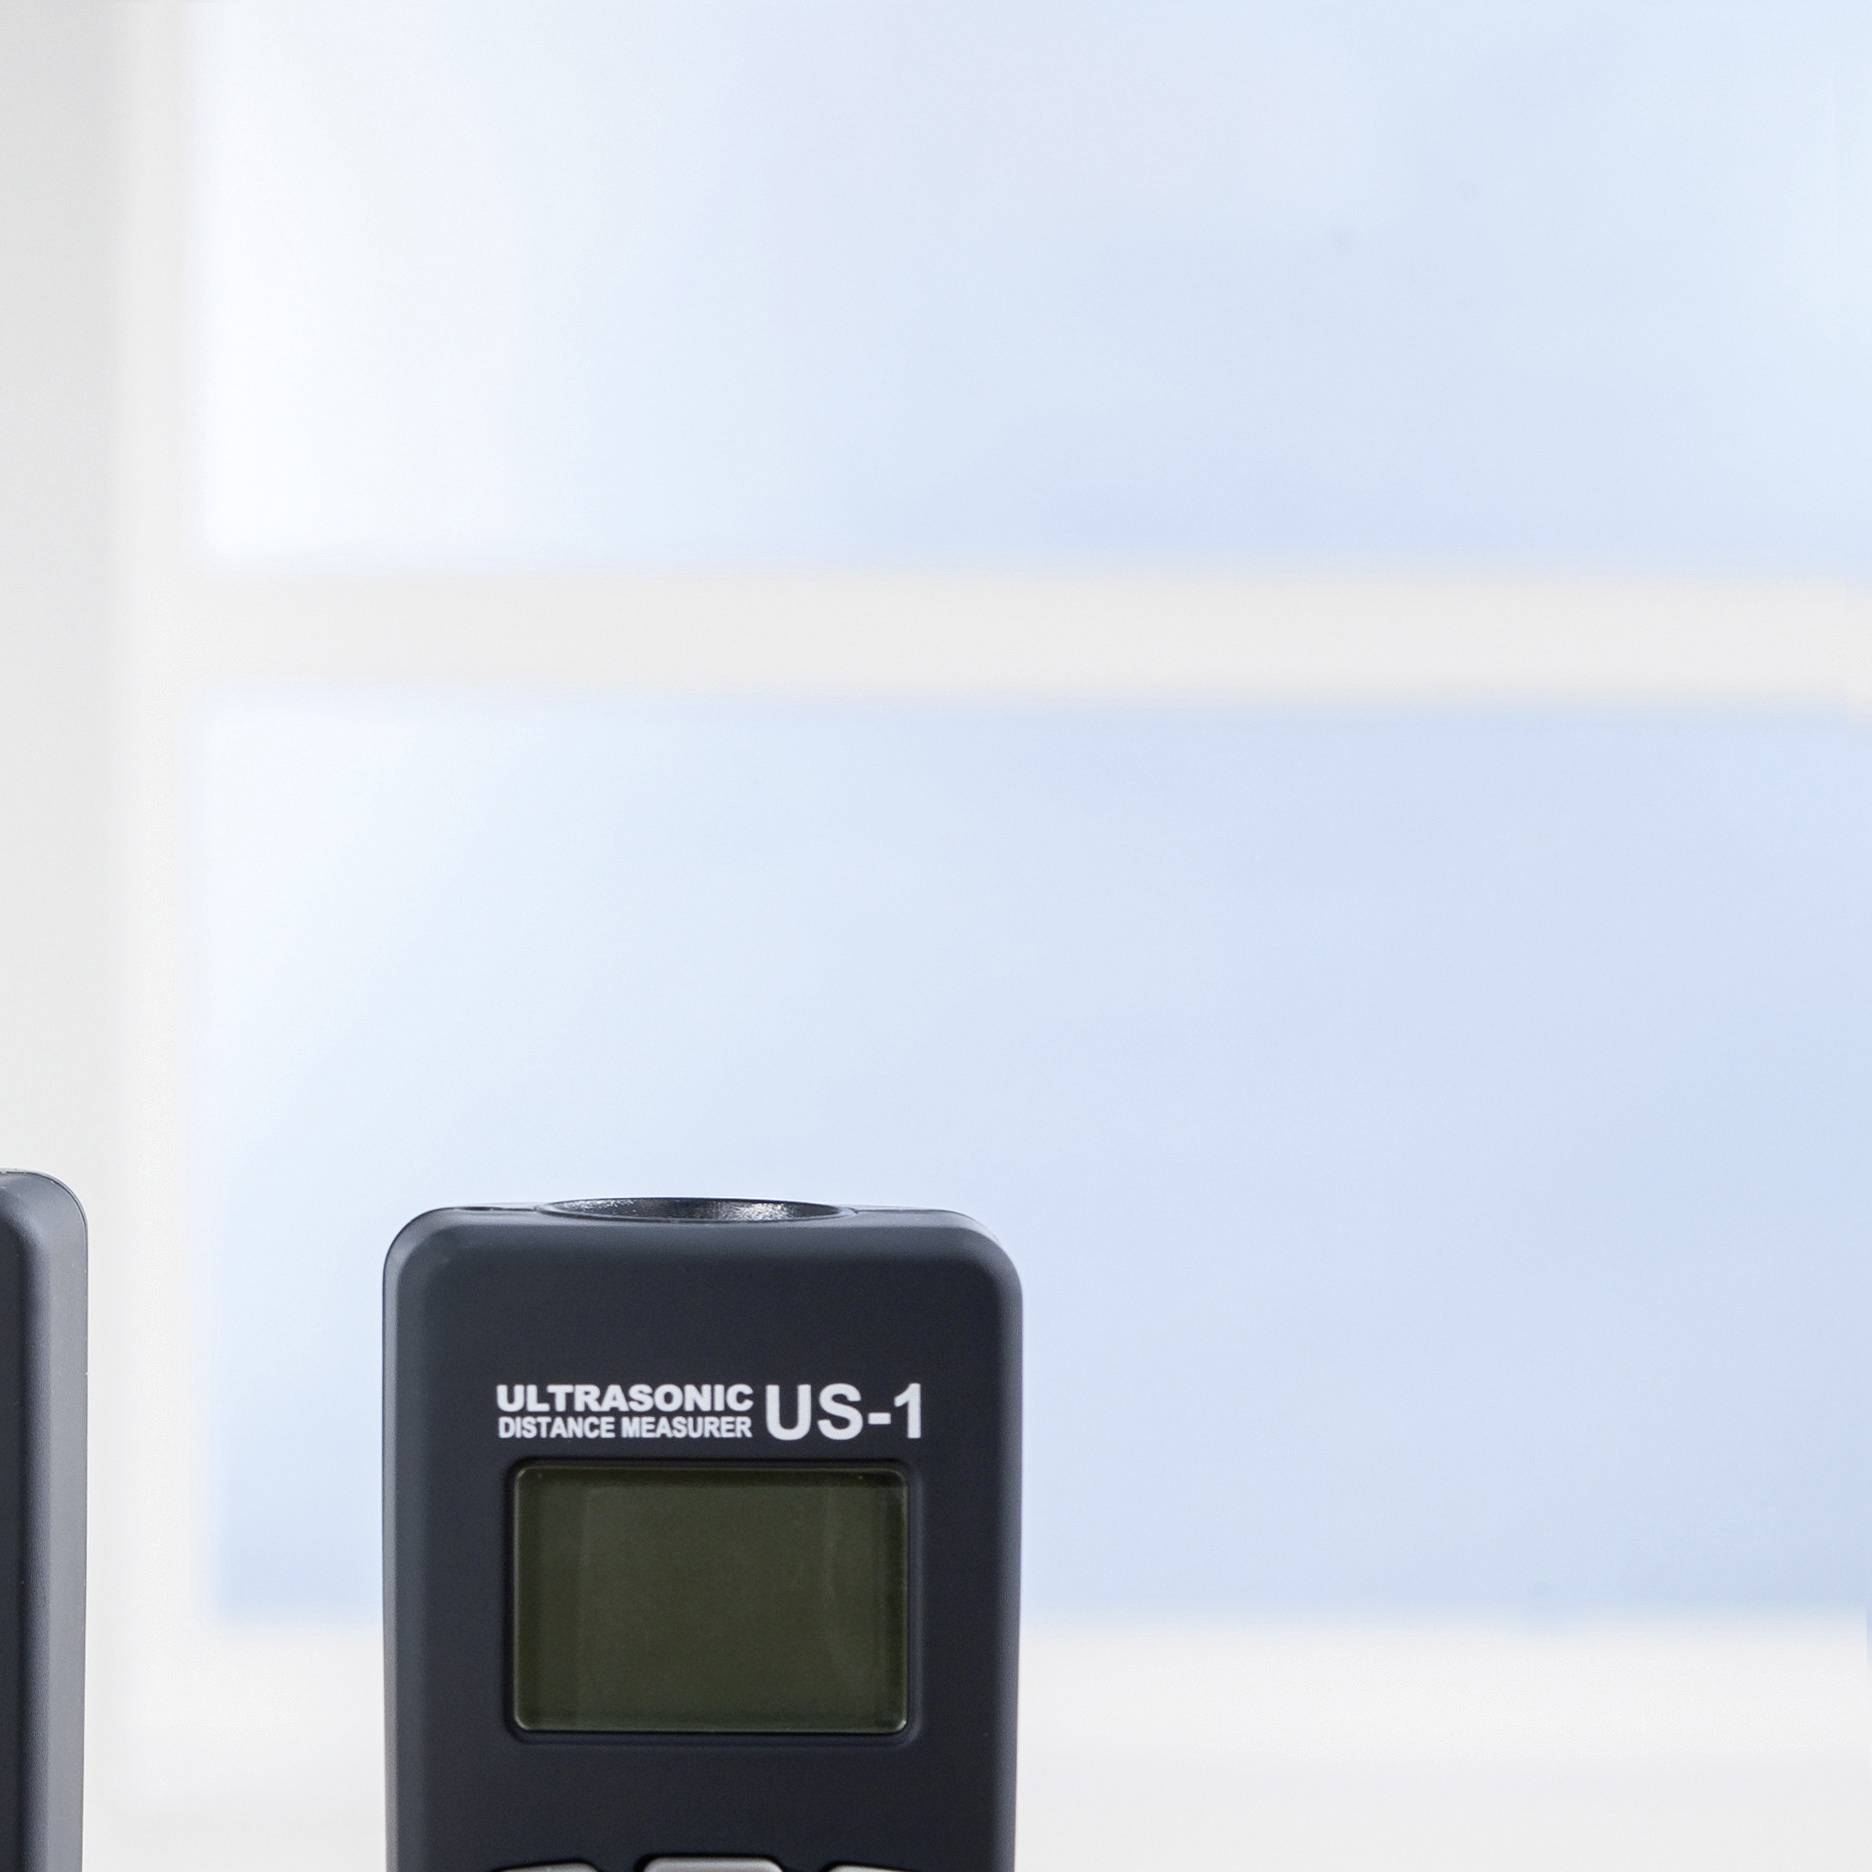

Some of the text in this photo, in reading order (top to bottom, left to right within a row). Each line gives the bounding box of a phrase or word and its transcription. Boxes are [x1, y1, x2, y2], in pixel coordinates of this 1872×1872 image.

[496, 1383, 754, 1413] ULTRASONIC
[765, 1382, 923, 1441] US-1
[498, 1414, 754, 1440] DISTANCE MEASURER
